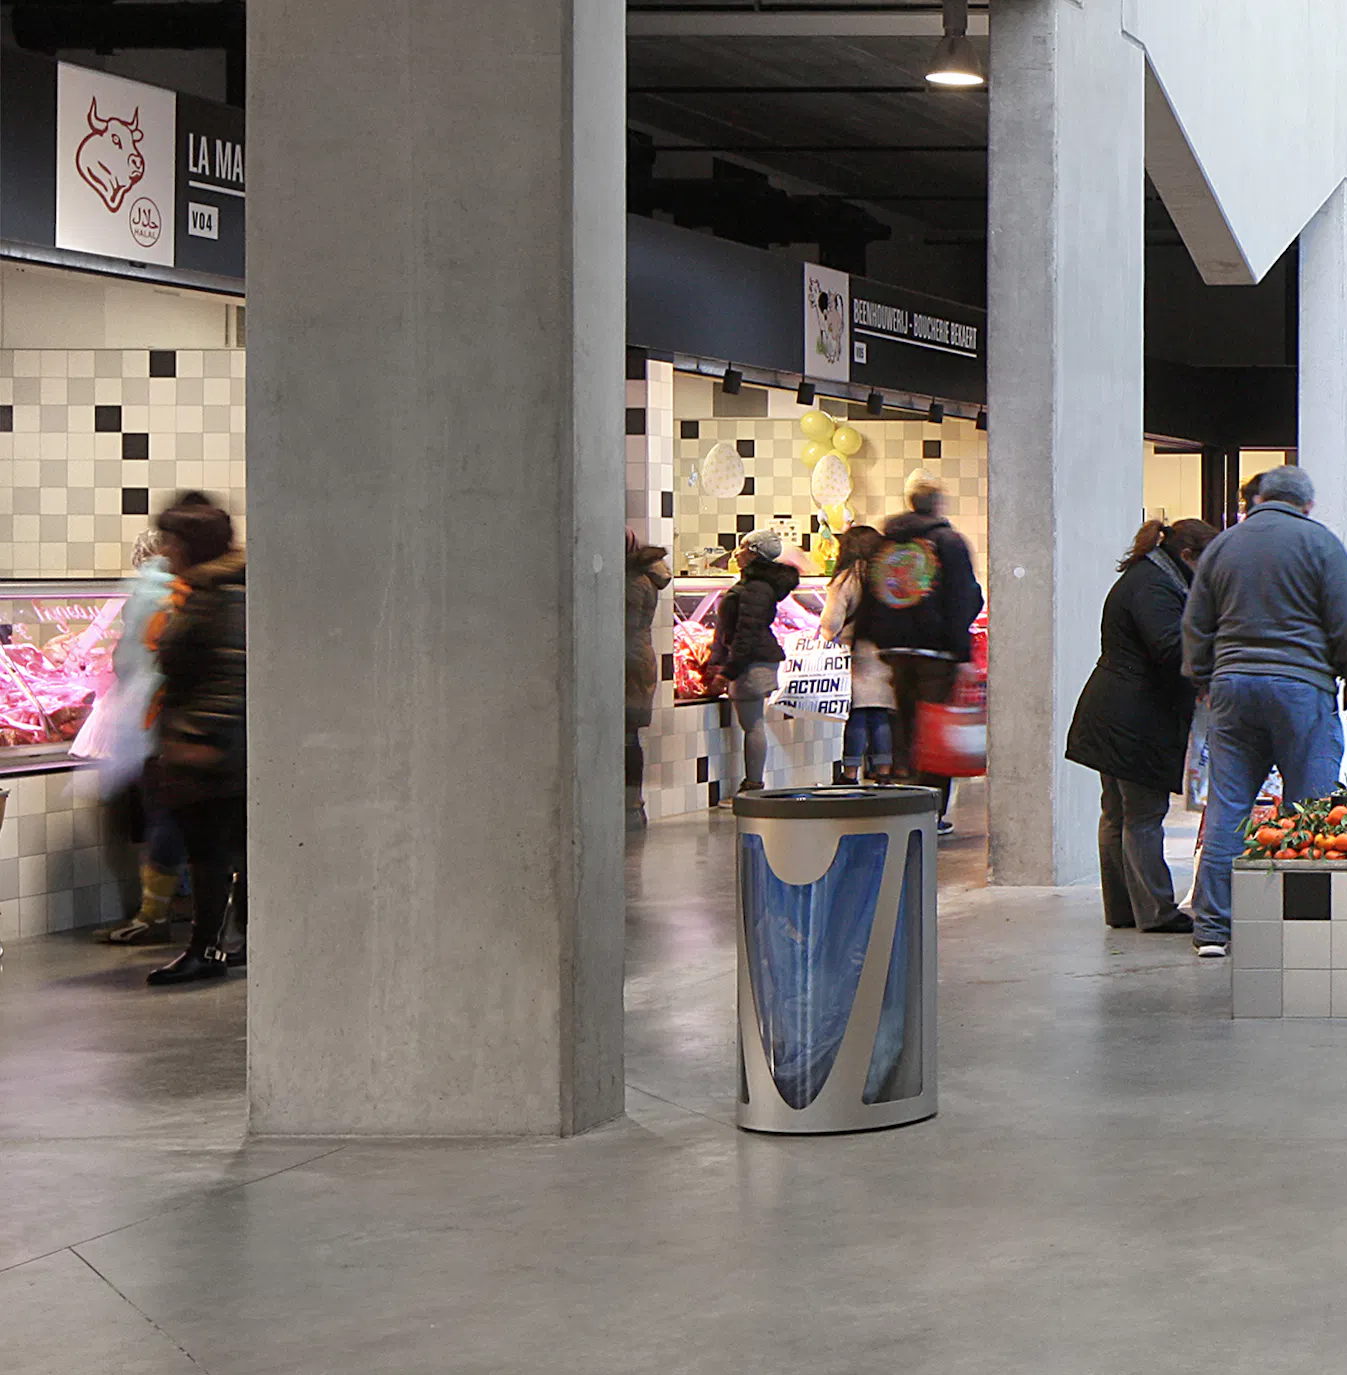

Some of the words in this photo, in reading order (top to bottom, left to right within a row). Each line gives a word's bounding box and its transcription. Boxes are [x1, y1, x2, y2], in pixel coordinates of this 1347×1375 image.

[189, 133, 210, 176] LA
[215, 139, 244, 183] MA
[192, 211, 212, 232] V04
[134, 228, 156, 239] HALAL
[854, 298, 908, 334] BEENHOUWERIJ
[913, 313, 949, 344] BOUCHERIE
[950, 322, 977, 350] BEKAERT
[788, 678, 840, 694] ACTION
